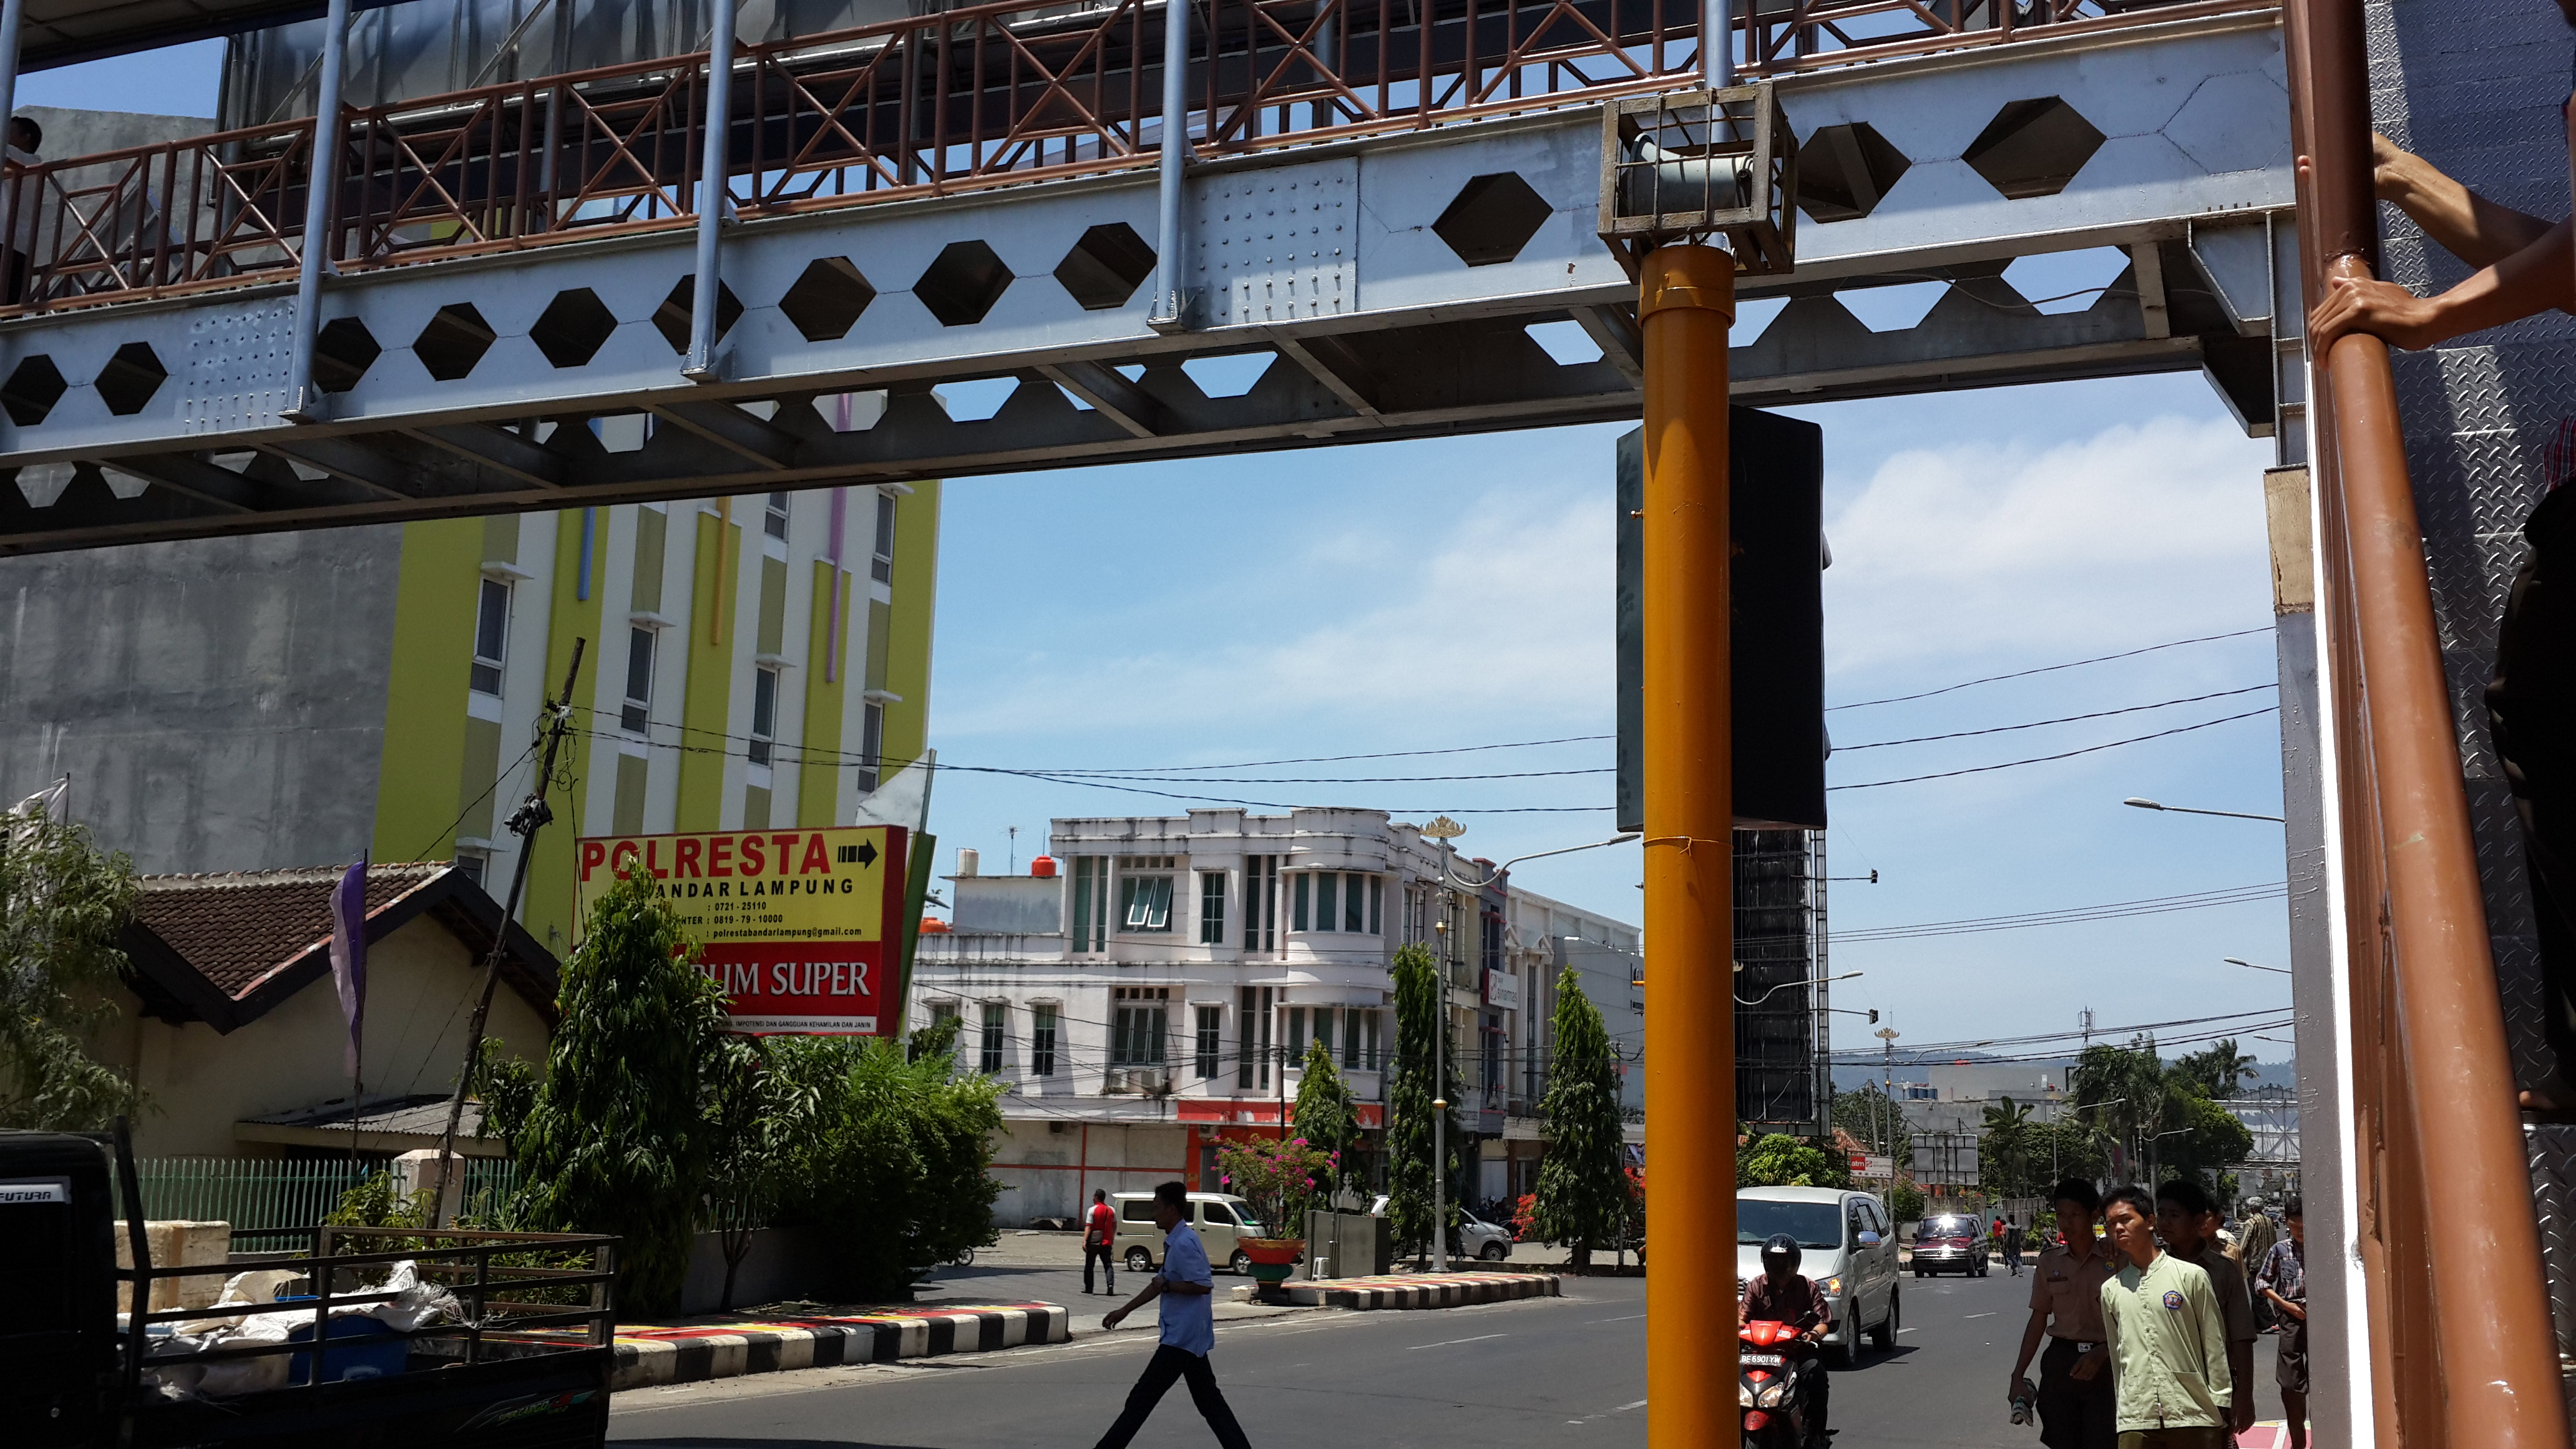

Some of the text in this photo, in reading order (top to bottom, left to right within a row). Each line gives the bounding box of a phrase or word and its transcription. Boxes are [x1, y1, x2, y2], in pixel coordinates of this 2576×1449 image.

[582, 834, 831, 881] POLRESTA
[655, 878, 853, 898] ANDAR LAMPUNG
[715, 902, 734, 911] 0721
[741, 901, 766, 910] 25110
[681, 916, 703, 925] NTER
[714, 915, 734, 924] 0819
[741, 915, 751, 924] 79
[758, 914, 783, 924] 10000
[713, 927, 862, 939] polrestabandarlampung@gmail.com
[770, 961, 871, 997] SUPER
[1741, 1355, 1751, 1363] BE
